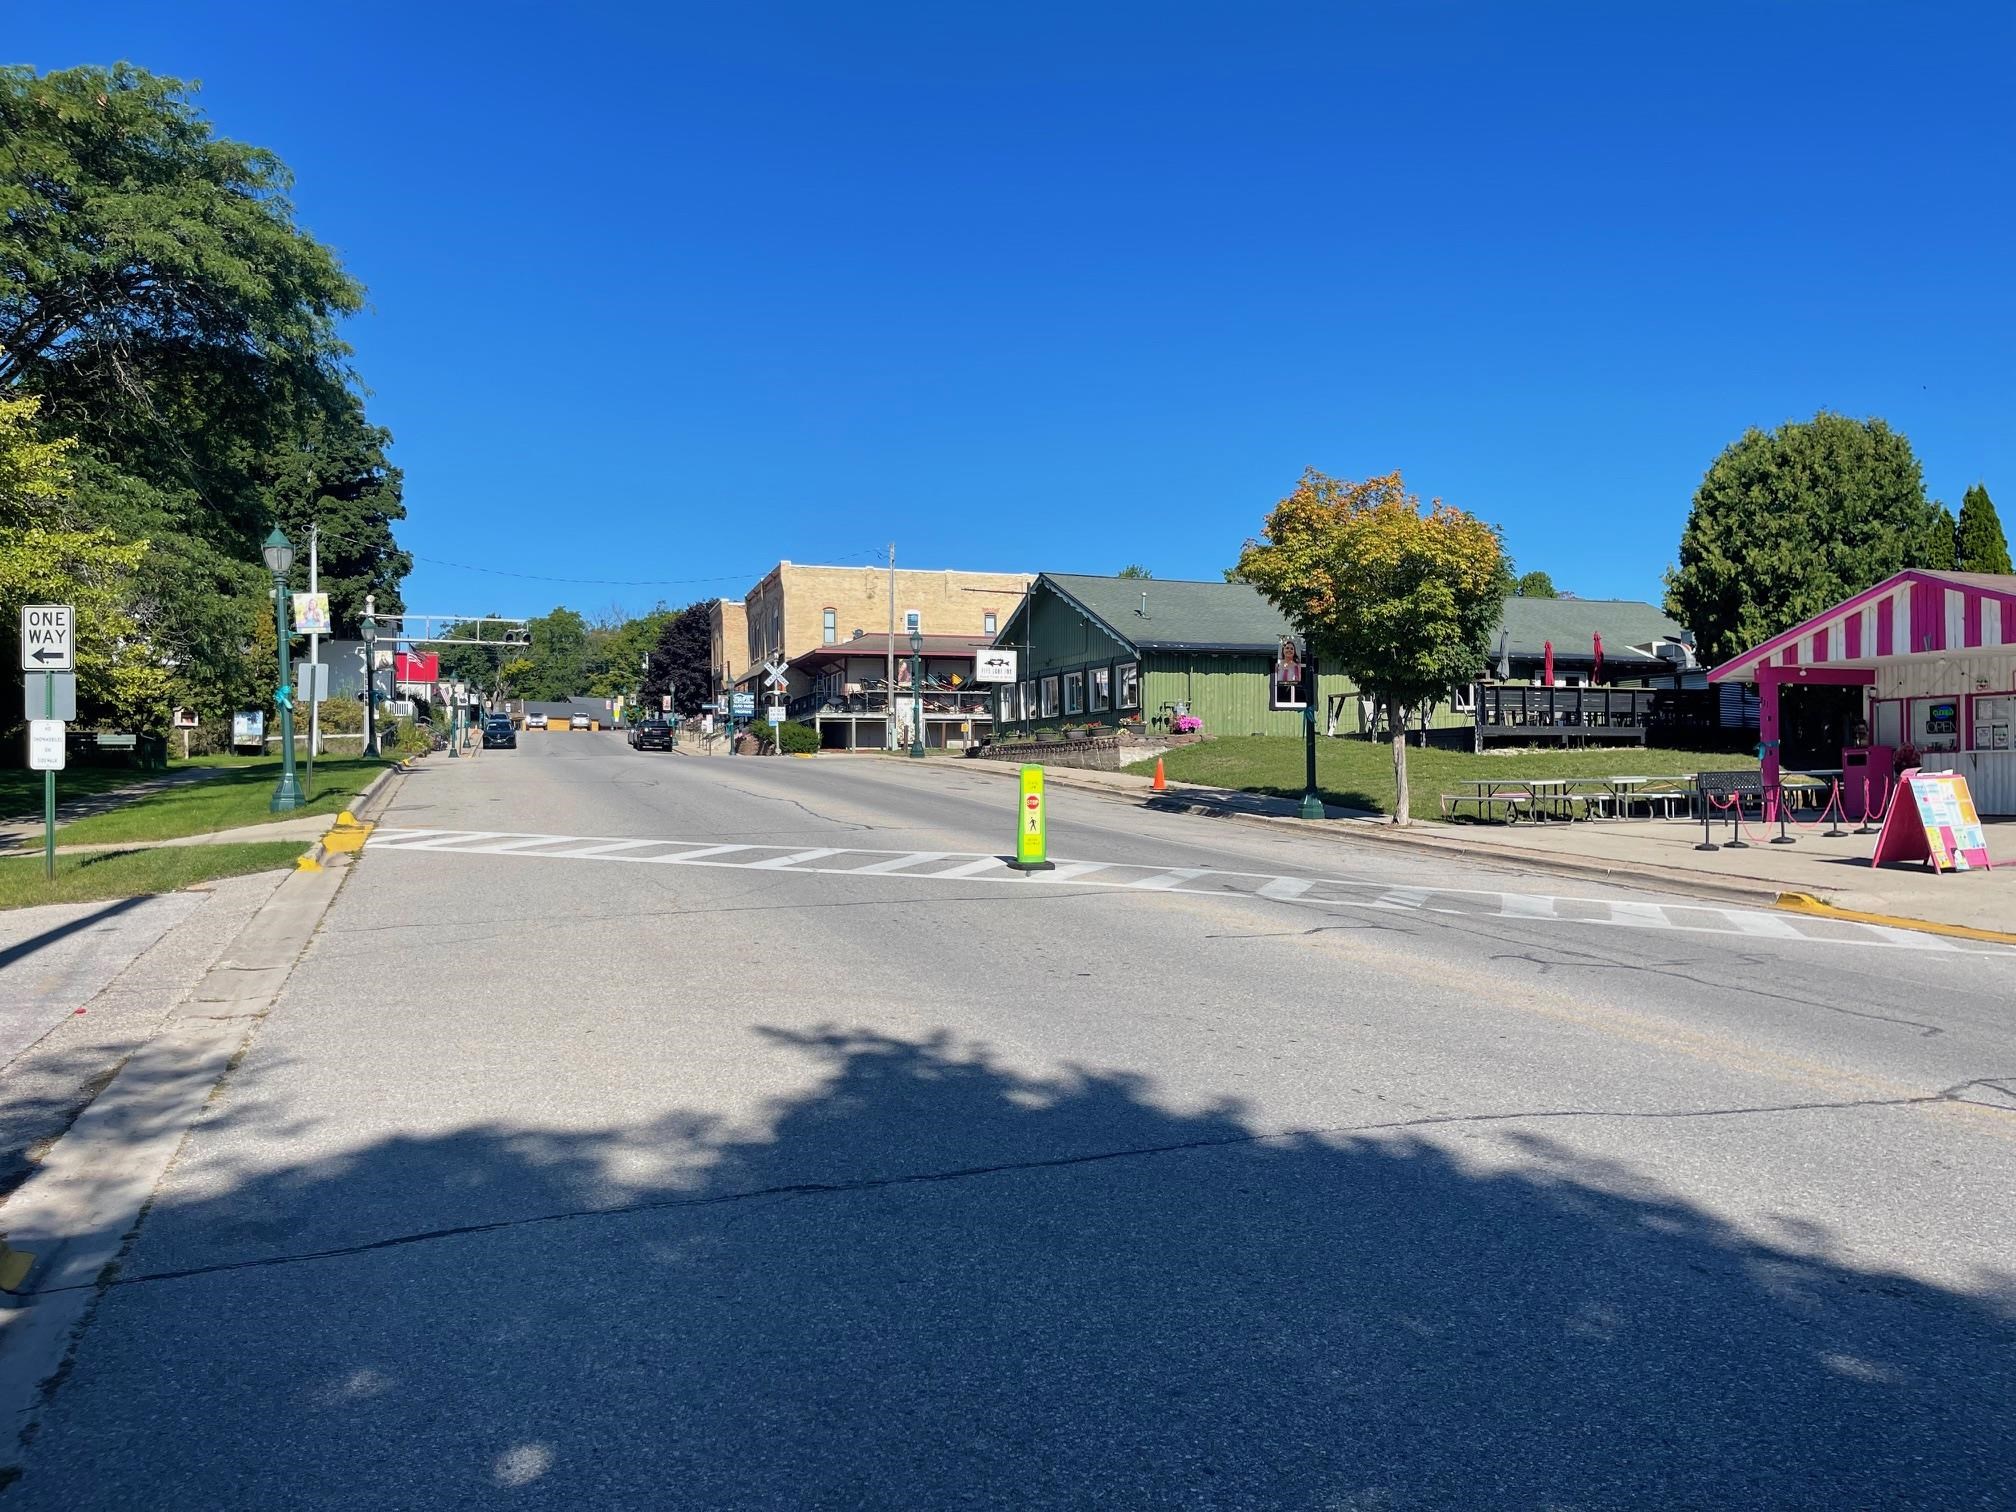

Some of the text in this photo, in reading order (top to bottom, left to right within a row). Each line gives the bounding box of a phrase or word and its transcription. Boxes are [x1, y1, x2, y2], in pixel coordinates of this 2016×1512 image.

[30, 612, 65, 626] ONE
[29, 629, 66, 644] WAY
[1927, 720, 1957, 733] OPEN
